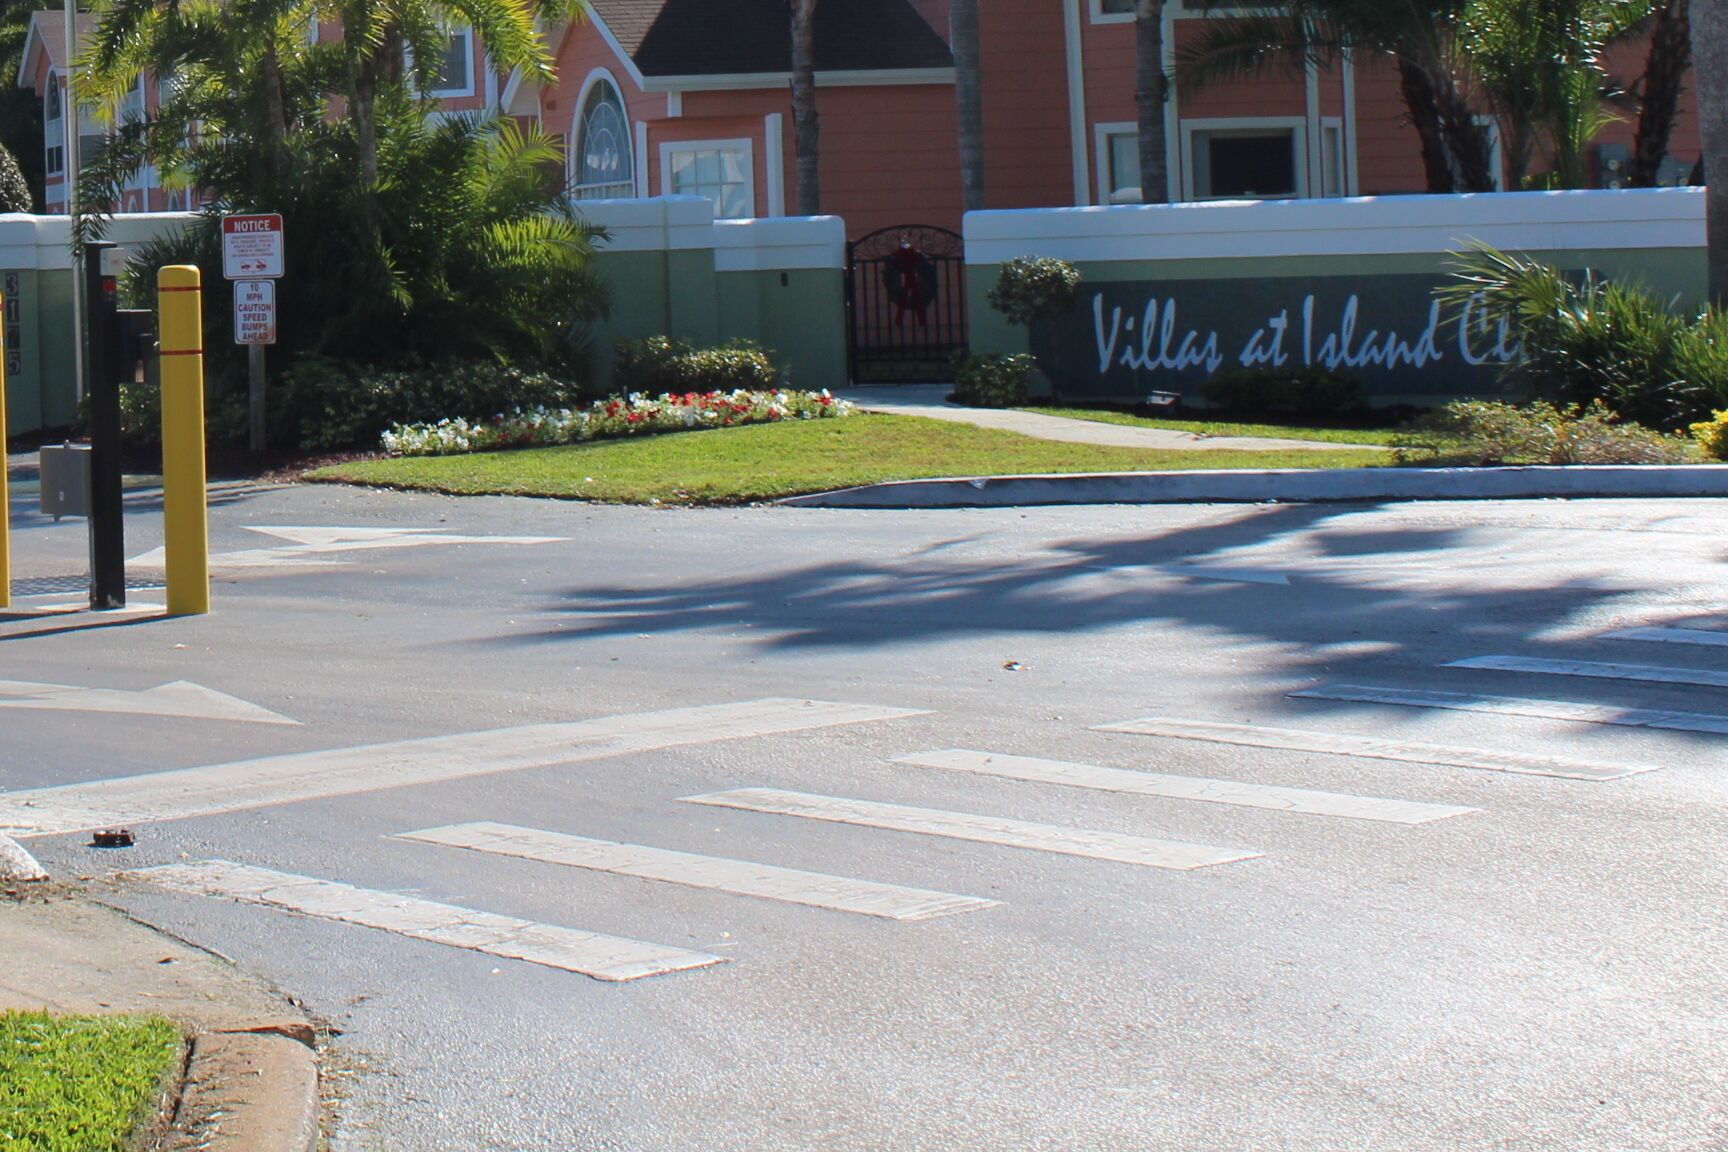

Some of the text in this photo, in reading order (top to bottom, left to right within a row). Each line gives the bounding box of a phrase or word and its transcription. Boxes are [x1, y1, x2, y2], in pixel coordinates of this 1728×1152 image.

[234, 220, 271, 232] NOTICE
[250, 283, 259, 292] 10
[246, 293, 263, 302] MPH
[238, 303, 272, 313] CAUTION
[243, 313, 267, 322] SPEED
[242, 322, 268, 332] BUMPS
[243, 332, 269, 341] AHEAD
[1093, 293, 1223, 374] Villas
[1239, 309, 1288, 367] at
[1303, 294, 1443, 372] Island
